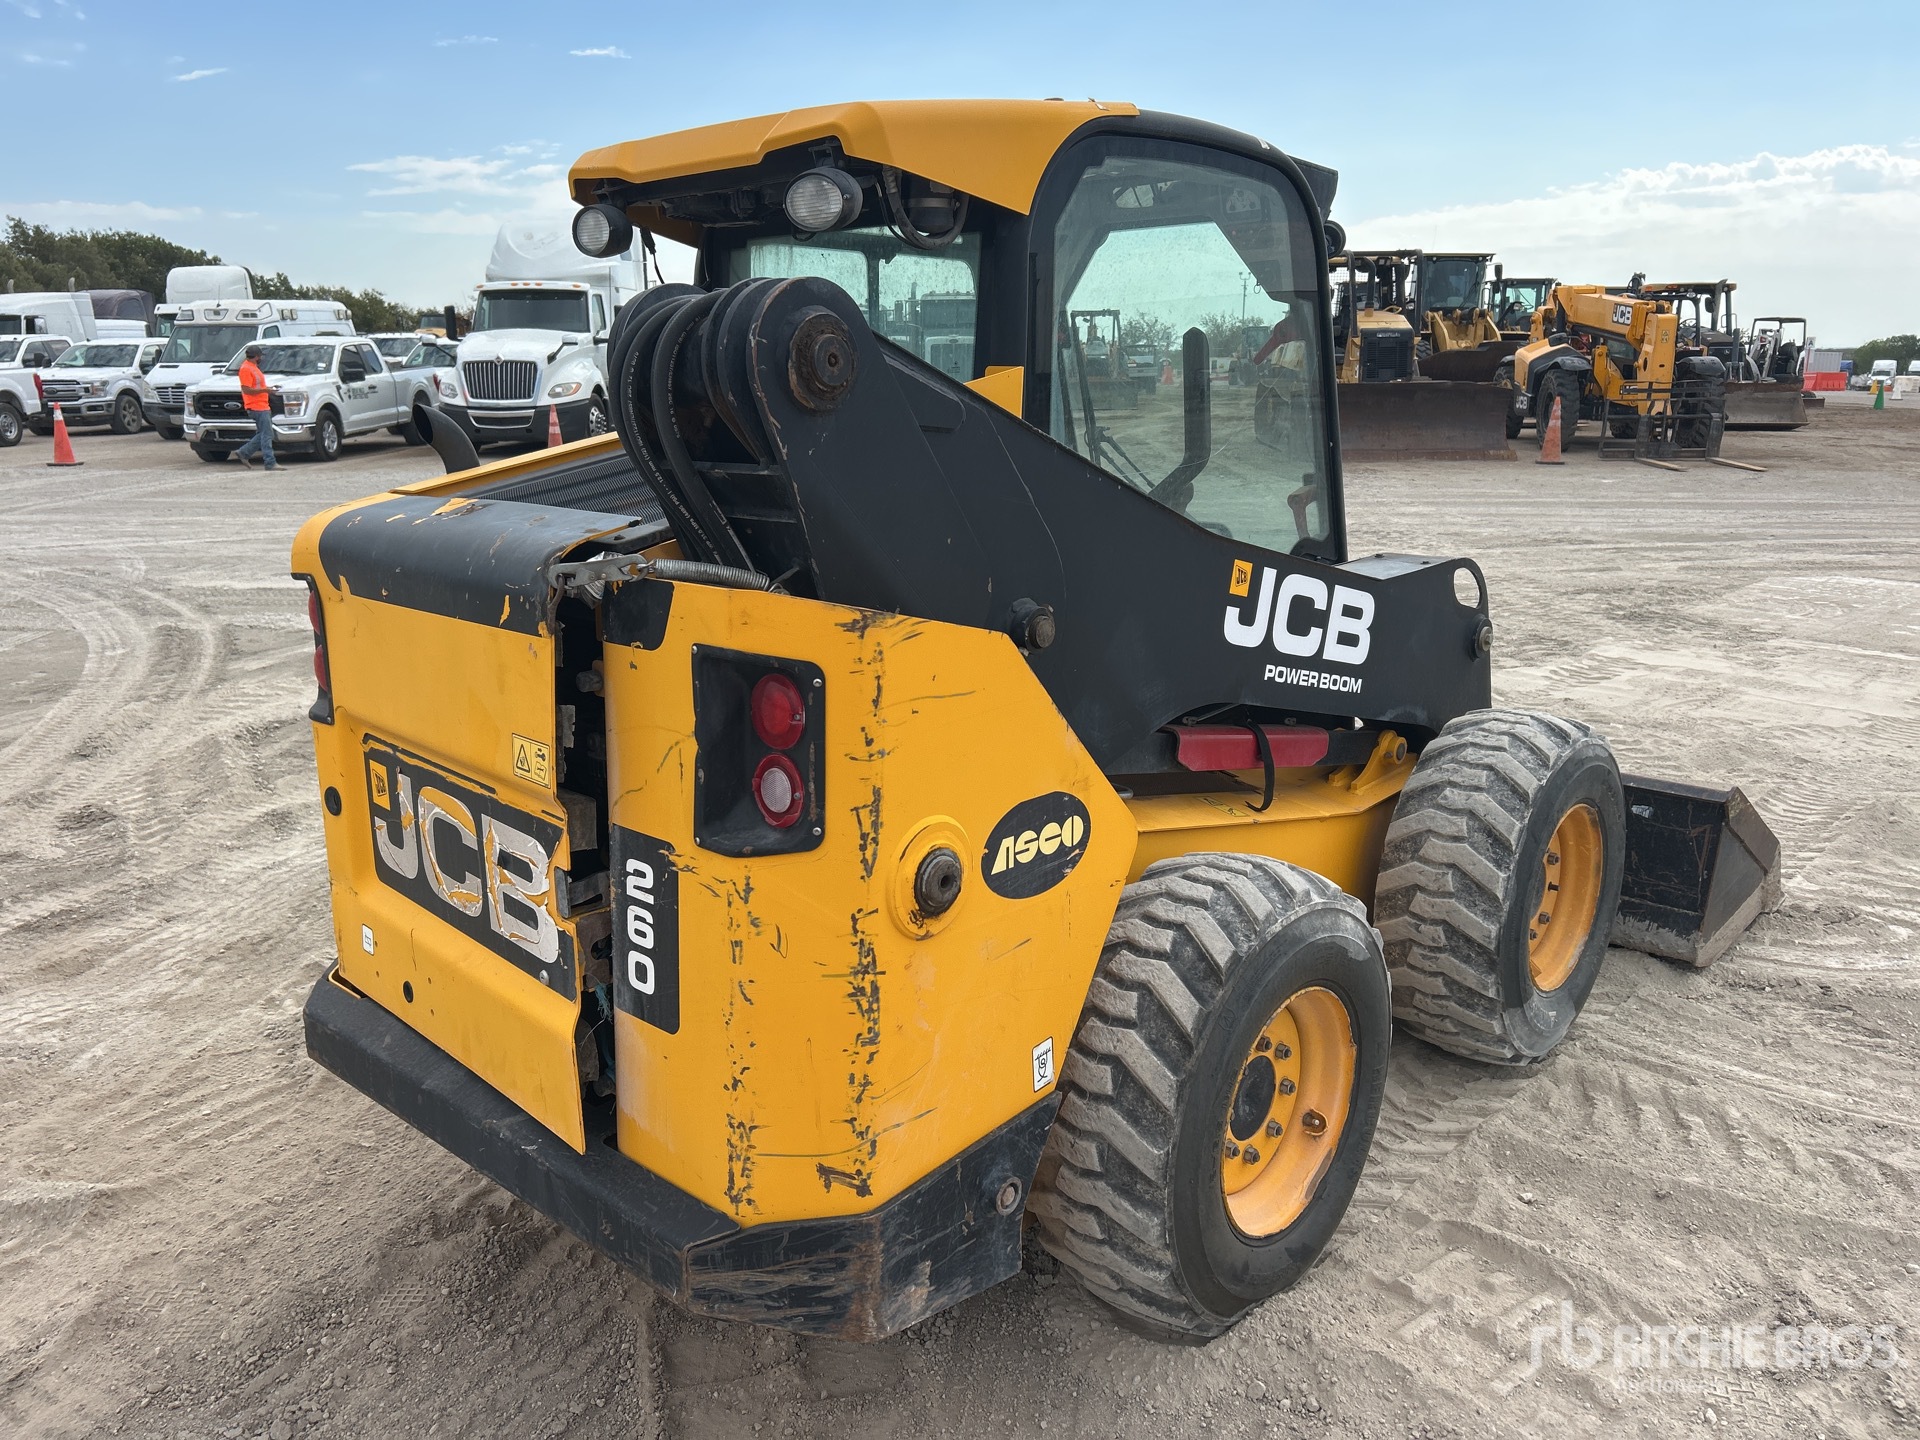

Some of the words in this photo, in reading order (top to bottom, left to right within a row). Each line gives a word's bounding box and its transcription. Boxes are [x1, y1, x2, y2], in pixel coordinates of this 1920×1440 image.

[1612, 304, 1633, 324] JCB
[1224, 566, 1375, 665] JCB
[374, 773, 559, 964] JCB
[990, 815, 1084, 875] ASCO
[626, 858, 655, 996] 260
